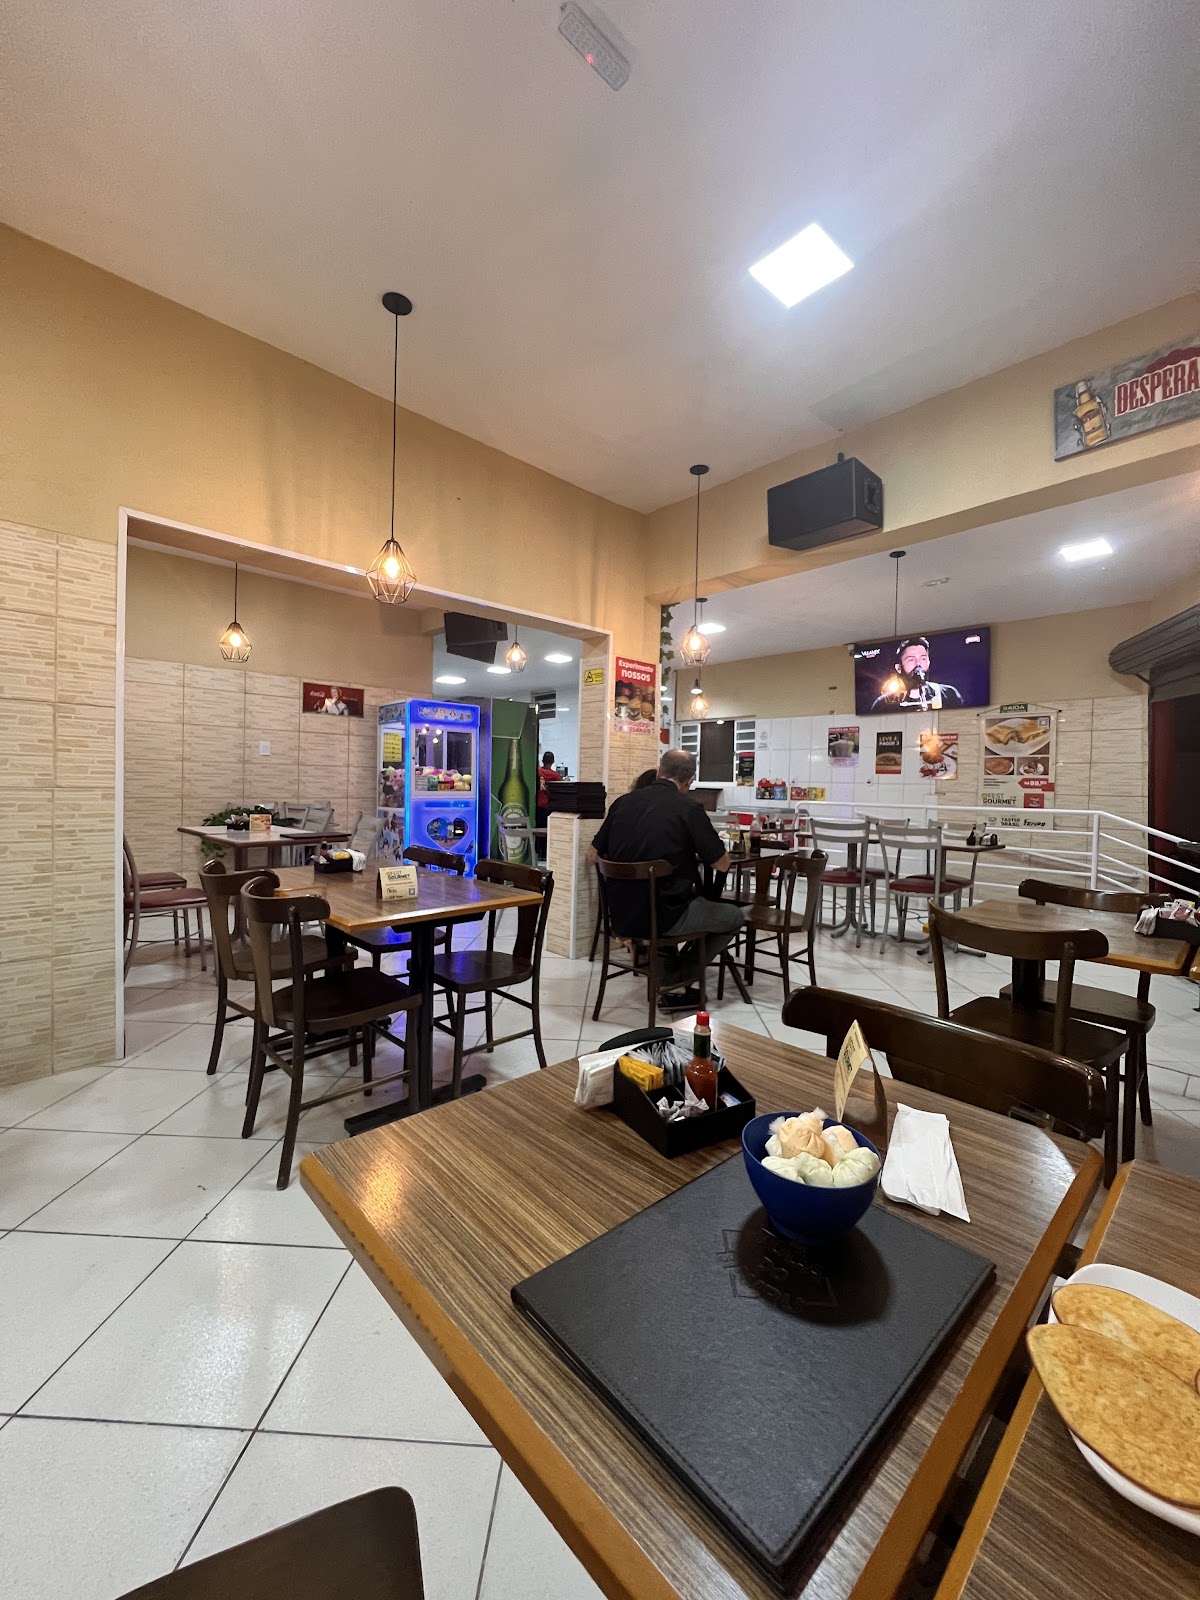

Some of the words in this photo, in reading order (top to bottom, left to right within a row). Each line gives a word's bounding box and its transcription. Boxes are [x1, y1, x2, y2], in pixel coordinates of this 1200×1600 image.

[1116, 356, 1200, 415] DESPERA
[618, 659, 654, 673] Experimente
[621, 669, 651, 682] nossos
